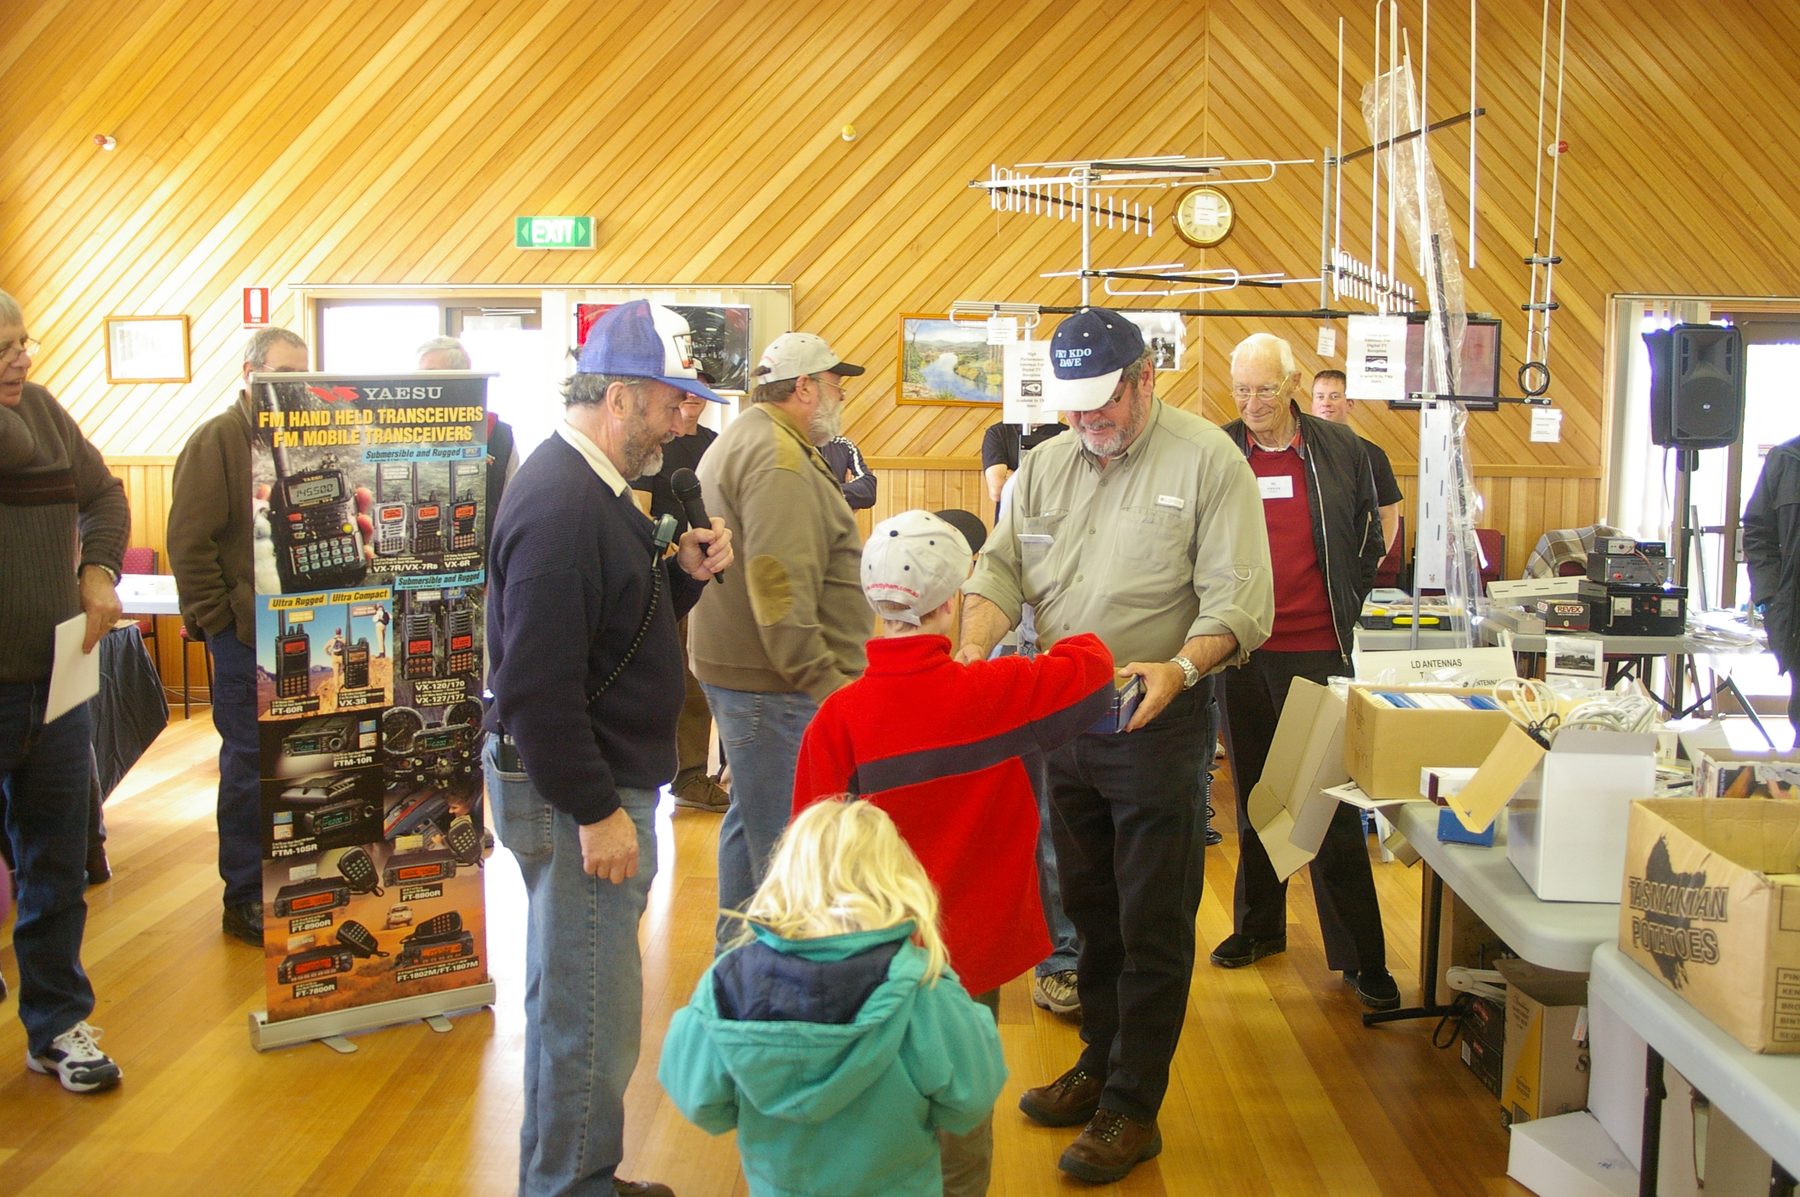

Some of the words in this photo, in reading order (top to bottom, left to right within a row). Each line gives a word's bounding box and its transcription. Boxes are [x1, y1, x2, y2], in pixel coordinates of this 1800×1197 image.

[531, 218, 576, 244] EXIT
[1068, 347, 1092, 358] KDO
[1060, 357, 1082, 368] DAVE
[362, 386, 443, 400] YAESU
[259, 411, 285, 428] FM
[289, 410, 331, 427] HAND
[335, 409, 374, 425] HELD
[377, 406, 484, 424] TRANSCEIVERS
[273, 432, 302, 448] FM
[303, 430, 360, 447] MOBILE
[365, 426, 473, 444] TRANSCEIVERS
[366, 449, 414, 460] Submersible
[416, 448, 430, 457] and
[432, 448, 461, 458] Rugged
[444, 560, 471, 568] VX-6R
[398, 575, 442, 586] Submersible
[444, 574, 457, 583] and
[457, 572, 480, 583] Rugged
[272, 598, 293, 608] Ultra
[295, 595, 325, 607] Rugged
[332, 591, 352, 602] Ultra
[353, 589, 388, 601] Compact
[1557, 605, 1582, 613] REVEX
[1422, 658, 1463, 668] ANTENNAS
[415, 680, 465, 691] VX-120/170
[339, 697, 367, 707] VX-3R
[415, 693, 465, 704] VX-127/177
[271, 705, 304, 715] FT-60R
[333, 756, 373, 768] FTM-10R
[1629, 875, 1729, 922] TASMANIAN
[1631, 915, 1720, 965] POTATOES
